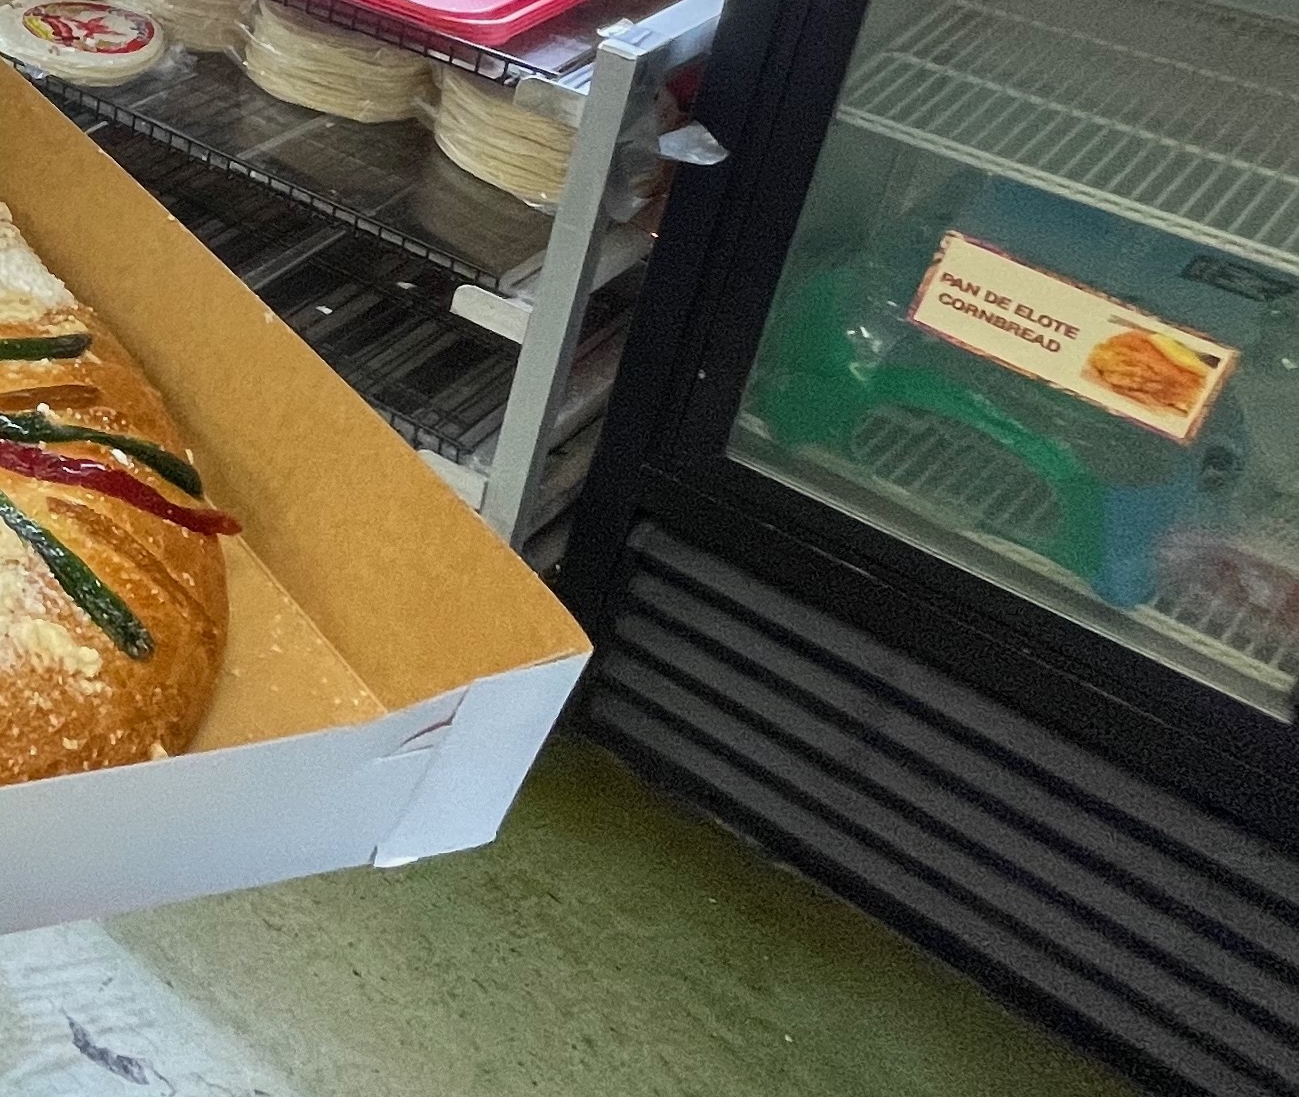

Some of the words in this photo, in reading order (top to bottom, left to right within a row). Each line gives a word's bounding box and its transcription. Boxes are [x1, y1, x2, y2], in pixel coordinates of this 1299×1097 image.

[938, 291, 1061, 354] CORNBREAD
[940, 271, 981, 297] PAN
[984, 289, 1013, 312] DE
[1014, 303, 1081, 340] ELOTE
